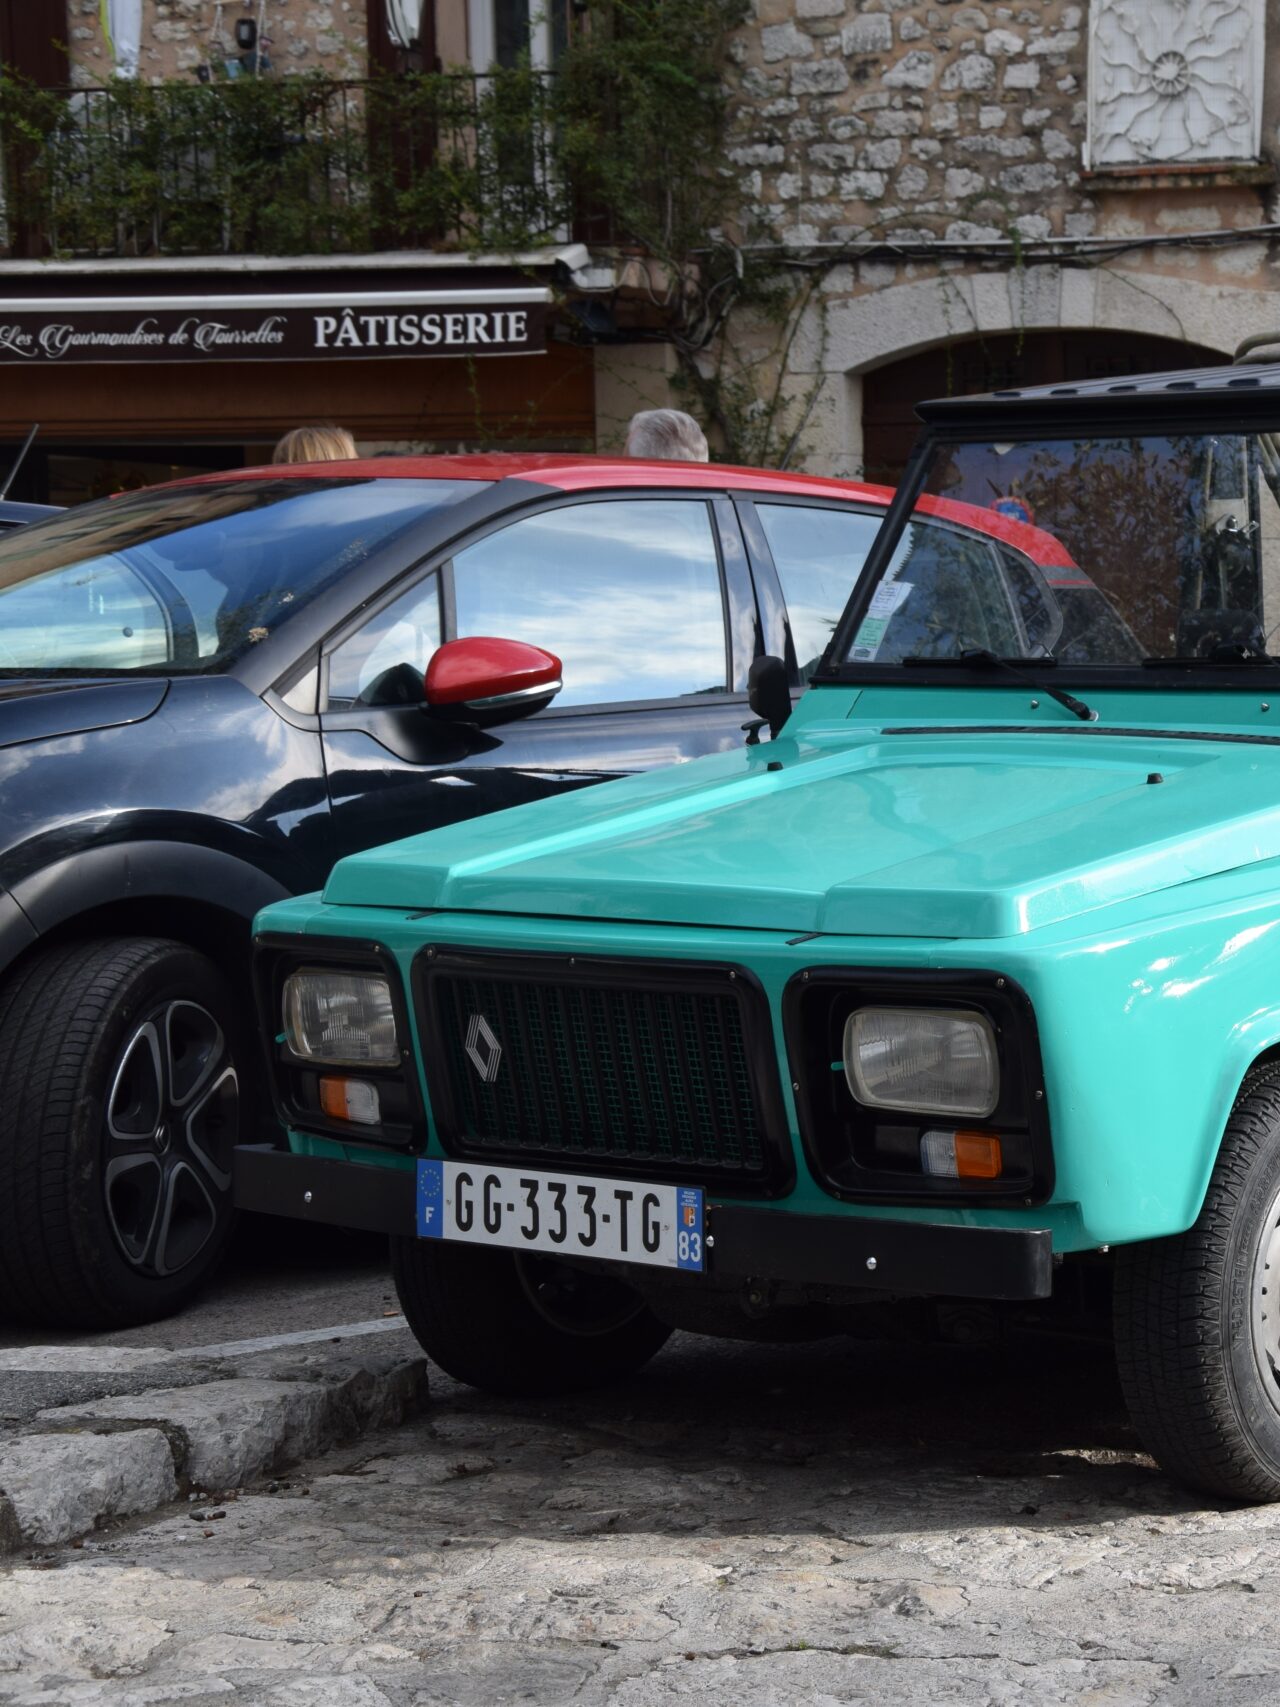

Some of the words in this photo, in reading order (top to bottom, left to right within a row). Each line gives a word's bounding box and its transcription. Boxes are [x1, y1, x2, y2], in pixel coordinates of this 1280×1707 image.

[0, 325, 38, 357] Les
[39, 318, 165, 358] Gourmandises
[168, 317, 200, 344] de
[193, 316, 288, 352] Tourrettes
[314, 308, 528, 347] PÂTISSERIE
[425, 1206, 435, 1223] F
[455, 1172, 661, 1252] GG-333-TG
[678, 1230, 701, 1262] 83
